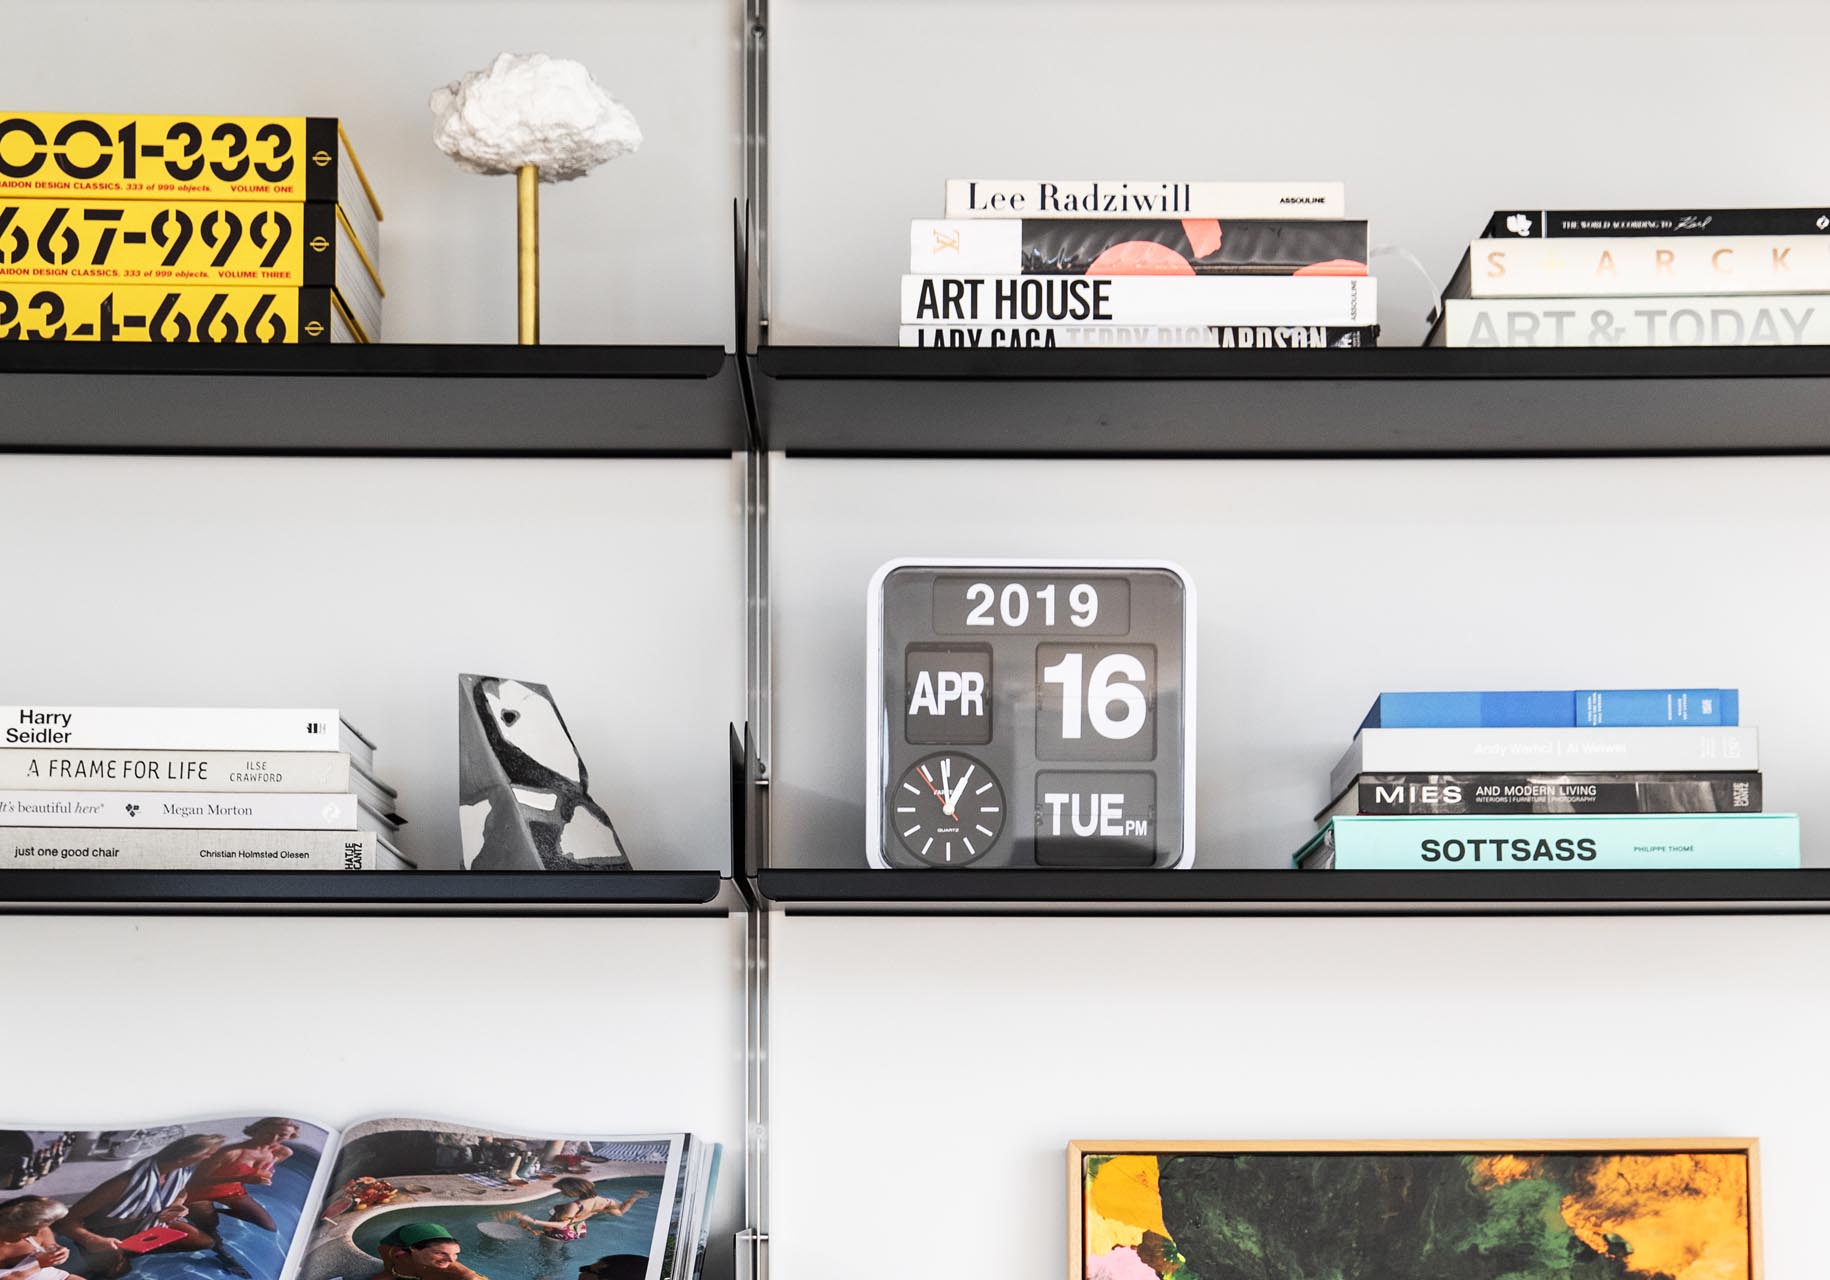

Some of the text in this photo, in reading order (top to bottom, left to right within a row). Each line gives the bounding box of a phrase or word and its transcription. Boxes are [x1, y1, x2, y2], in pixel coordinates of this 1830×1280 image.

[0, 117, 295, 182] 001-333
[0, 181, 32, 189] AIDON
[35, 181, 70, 189] DESIGN
[73, 182, 123, 190] CLASSICS.
[126, 183, 143, 191] 333
[146, 183, 155, 191] of
[178, 184, 212, 193] objects.
[230, 185, 270, 193] VOLUME
[968, 182, 1191, 212] Lee Radziwill
[1279, 197, 1327, 205] ASSOULINE
[0, 206, 293, 268] 667-999
[71, 269, 121, 277] CLASSICS.
[176, 270, 209, 279] objects.
[218, 271, 258, 279] VOLUME
[916, 279, 1113, 321] ART HOUSE
[1466, 308, 1816, 347] ART & TODAY
[966, 582, 1099, 628] 2019
[908, 670, 985, 716] APR
[1043, 652, 1147, 740] 16
[20, 709, 72, 728] Harry
[6, 727, 72, 743] Seidler
[26, 759, 208, 780] A FRAME FOR LIFE
[246, 761, 268, 771] ILSE
[229, 773, 283, 783] CRAWFORD
[1375, 785, 1462, 804] MIES
[1475, 784, 1597, 797] AND MODERN LIVING
[18, 801, 72, 814] beautiful
[163, 804, 253, 817] Megan Morton
[1044, 793, 1148, 837] TUE PM
[15, 846, 120, 859] just one good chair
[199, 848, 310, 859] Christian Holmsted Olesen
[346, 843, 354, 869] HATJE
[354, 843, 362, 869] CANTZ
[1421, 838, 1597, 862] SOTTSASS
[1667, 844, 1693, 852] THOMÉ
